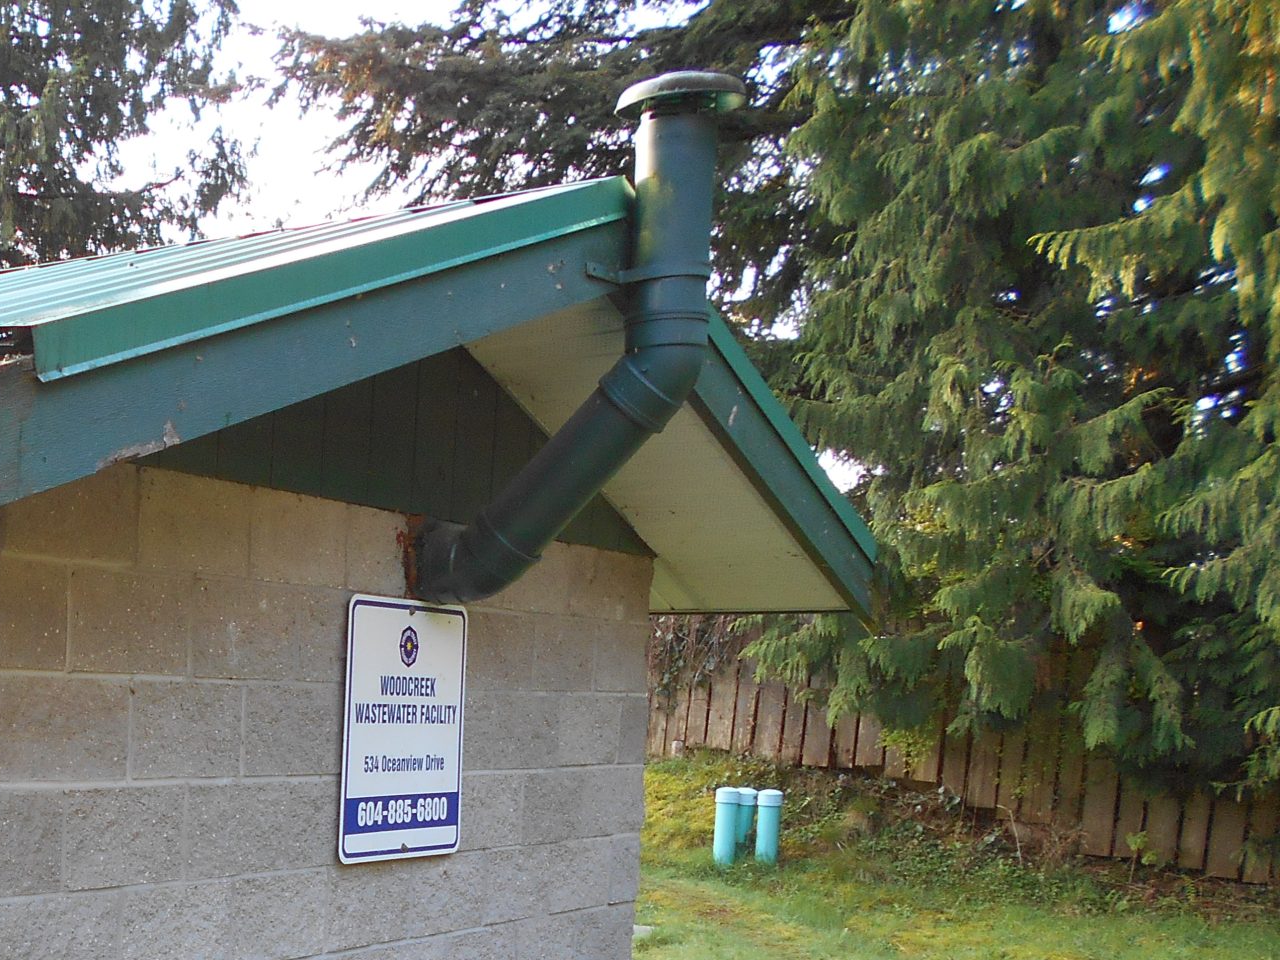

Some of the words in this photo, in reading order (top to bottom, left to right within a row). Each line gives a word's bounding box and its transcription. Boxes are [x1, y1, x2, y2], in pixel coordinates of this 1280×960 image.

[380, 675, 436, 697] WOODCREEK
[355, 703, 417, 724] WASTEWATER
[420, 704, 457, 724] FACILITY
[364, 755, 379, 773] 534
[381, 755, 424, 772] Oceanview
[425, 754, 445, 771] Drive
[357, 797, 447, 827] 604-885-6800
